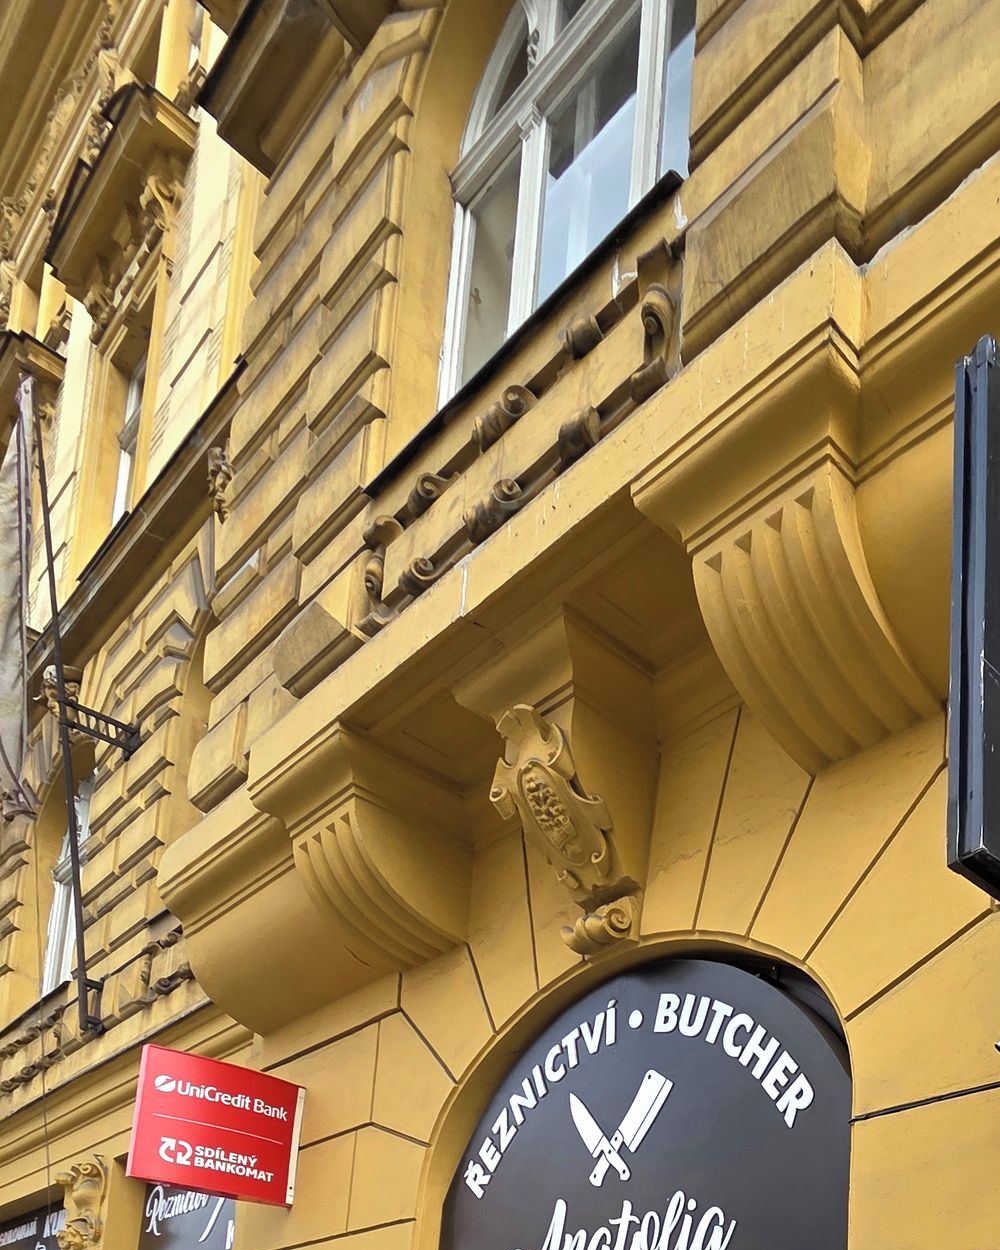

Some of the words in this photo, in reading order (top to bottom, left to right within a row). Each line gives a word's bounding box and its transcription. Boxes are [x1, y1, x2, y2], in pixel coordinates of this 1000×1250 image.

[177, 1079, 252, 1111] UniCredit
[253, 1098, 288, 1122] Bank
[463, 999, 617, 1199] ŘEZNICTVÍ
[653, 993, 815, 1129] BUTCHER
[193, 1156, 274, 1183] BANKOMAT
[194, 1145, 258, 1167] SDÍLENÝ
